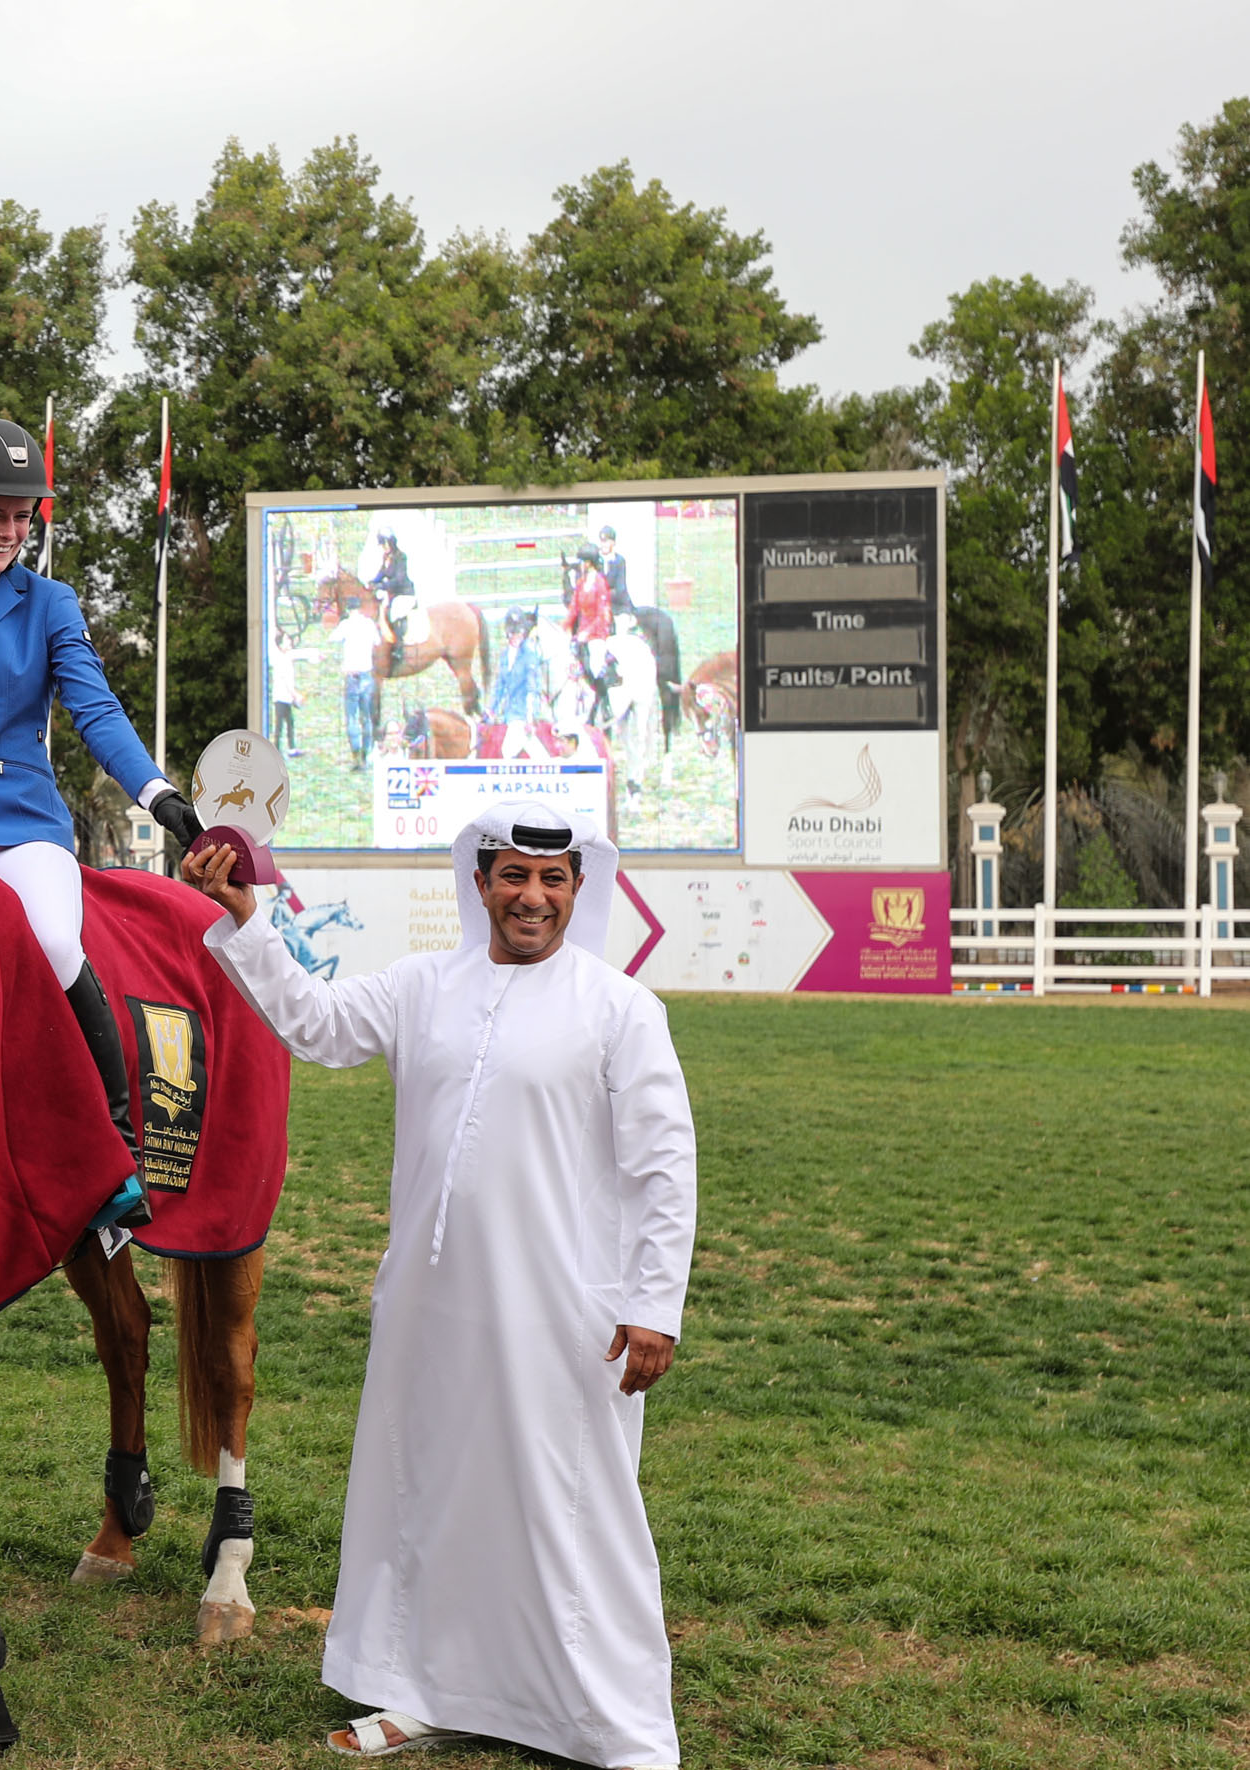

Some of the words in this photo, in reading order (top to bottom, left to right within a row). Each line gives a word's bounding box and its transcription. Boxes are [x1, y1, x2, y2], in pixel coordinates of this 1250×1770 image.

[763, 548, 837, 567] Number
[863, 545, 918, 564] Rank
[812, 611, 865, 630] Time
[766, 667, 844, 687] Faults/
[851, 666, 913, 686] Point
[492, 782, 570, 794] KAPSALIS
[788, 816, 823, 832] Abu
[830, 816, 882, 833] Dhabi
[787, 834, 830, 849] Sports
[833, 834, 882, 849] Council
[409, 923, 447, 934] FBMA
[409, 939, 458, 952] SHOW
[144, 1135, 162, 1149] FATIMA
[163, 1138, 175, 1152] BINT
